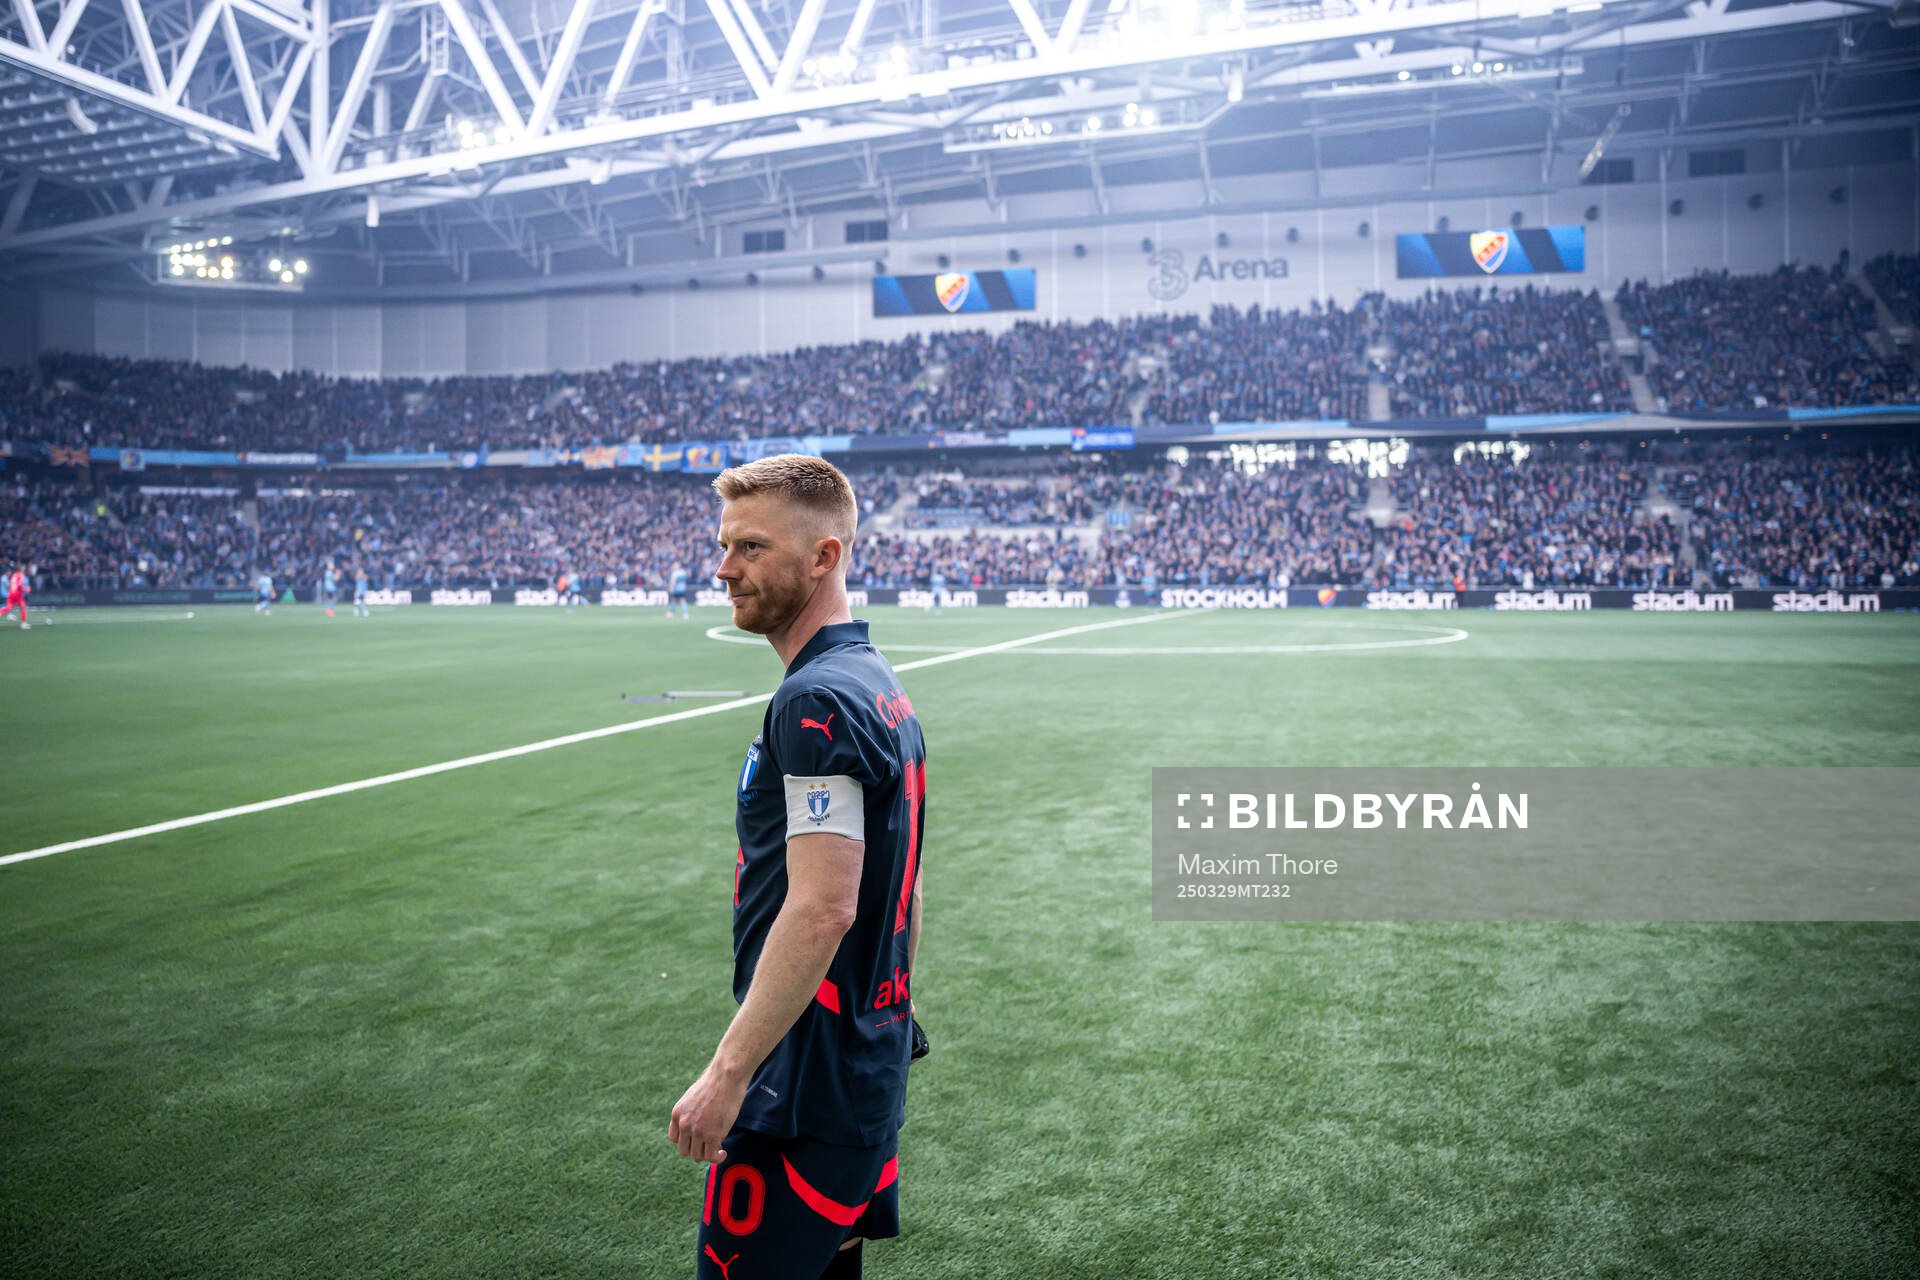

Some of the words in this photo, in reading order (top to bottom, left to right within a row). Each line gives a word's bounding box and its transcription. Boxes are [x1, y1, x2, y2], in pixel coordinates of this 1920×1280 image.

[1193, 255, 1290, 282] Arena
[1005, 588, 1089, 608] stadium
[1160, 588, 1288, 609] STOCKHOLM
[1366, 589, 1458, 610] stadium
[1494, 589, 1592, 611] stadium
[1632, 590, 1734, 612] stadium
[1772, 590, 1880, 612] stadium
